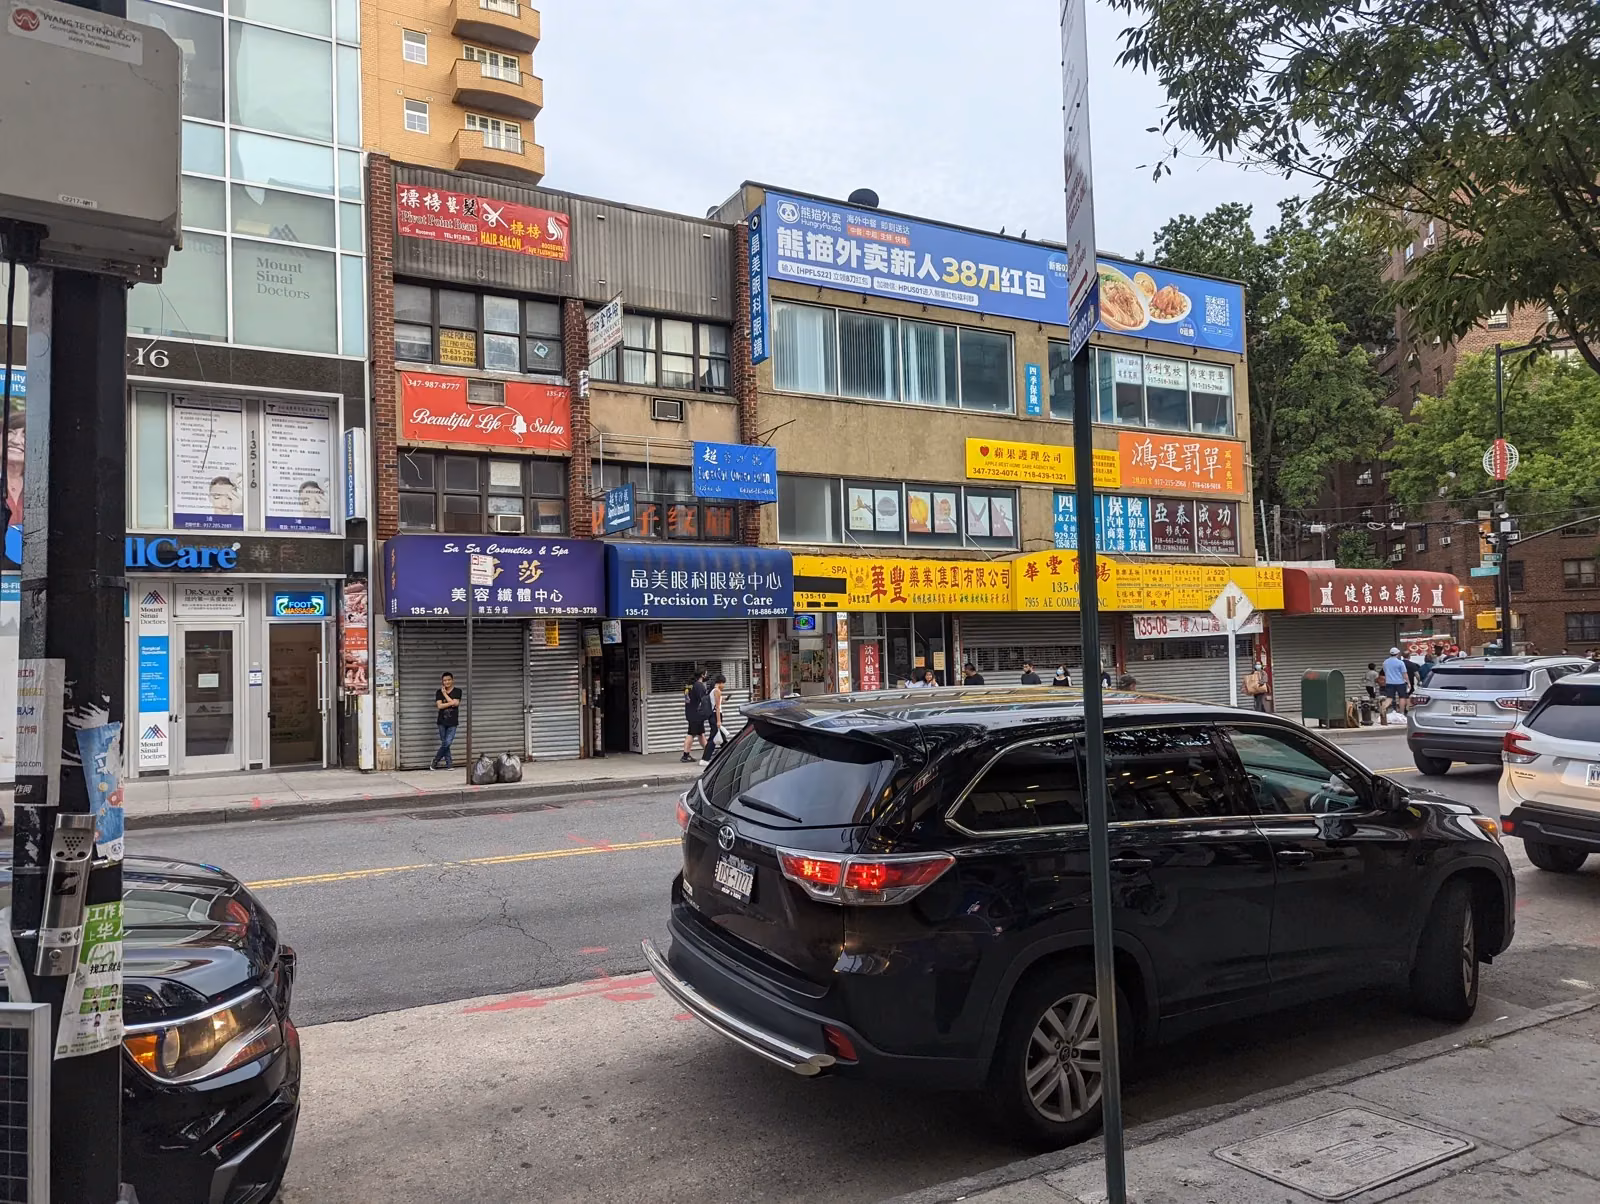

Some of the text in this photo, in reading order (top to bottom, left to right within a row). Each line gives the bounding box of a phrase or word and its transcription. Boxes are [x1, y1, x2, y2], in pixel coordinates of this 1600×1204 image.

[43, 13, 73, 27] WANG
[75, 21, 138, 43] TECHNOLOGY
[401, 210, 427, 225] Pivot
[427, 214, 453, 228] Point
[801, 206, 841, 225] 熊猫外卖
[801, 219, 842, 232] HungryPanda
[257, 257, 303, 273] Mount
[776, 226, 1046, 299] 熊猫外卖新人38刀红包
[257, 271, 293, 285] Sinai
[257, 284, 310, 300] Doctors
[408, 379, 460, 390] 347-987-8777
[410, 408, 564, 435] Beautiful Life Salon
[994, 447, 1061, 463] 蘋果護理公司
[1131, 437, 1223, 480] 鴻運罰單
[972, 467, 1018, 477] 347-732-4074
[1023, 471, 1067, 480] 718-439-1321
[1106, 516, 1124, 528] 汽車
[1154, 502, 1231, 527] 亞泰 成功
[443, 543, 569, 557] Sa Sa Cosmetics & Spa
[831, 566, 847, 574] SPA
[630, 569, 782, 591] 晶美眼科眼鏡中心
[1052, 582, 1079, 593] 135-0
[451, 588, 563, 603] 美容纖體中心
[643, 593, 773, 608] Precision Eye Care
[1344, 582, 1421, 604] 健富西藥房
[1043, 597, 1053, 607] AE
[1056, 597, 1080, 607] COMPA
[1098, 598, 1109, 608] NC.
[1411, 605, 1425, 613] Inc.
[411, 607, 450, 615] 135-12A
[625, 608, 788, 616] 135-12 718-886-8637
[17, 725, 37, 735] 工作网
